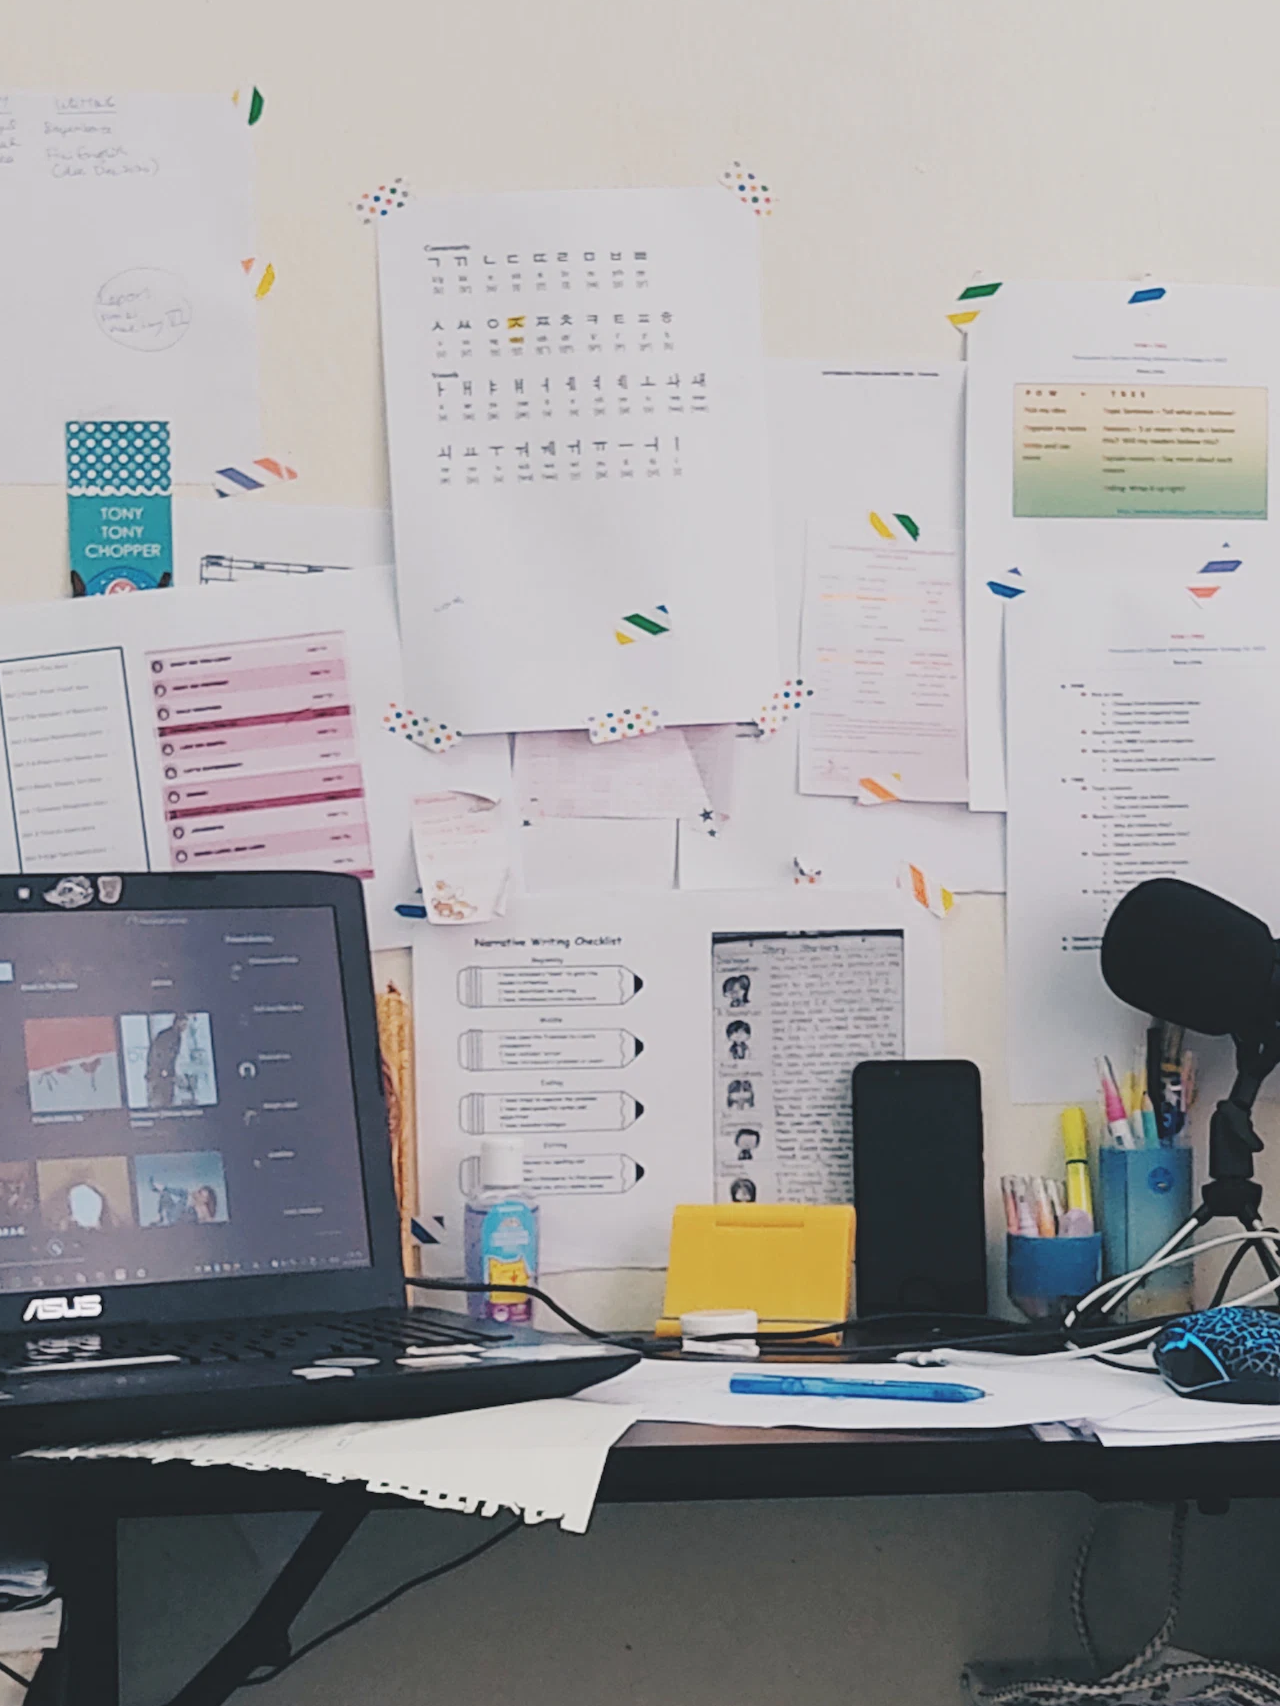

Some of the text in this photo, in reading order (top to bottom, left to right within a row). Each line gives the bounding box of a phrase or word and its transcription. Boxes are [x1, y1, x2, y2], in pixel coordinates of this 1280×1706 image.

[100, 507, 143, 520] TONY
[101, 526, 143, 539] TONY
[85, 544, 161, 558] CHOPPER
[530, 937, 570, 948] Writing
[575, 936, 622, 945] Checklist
[23, 1294, 101, 1321] ASUS
